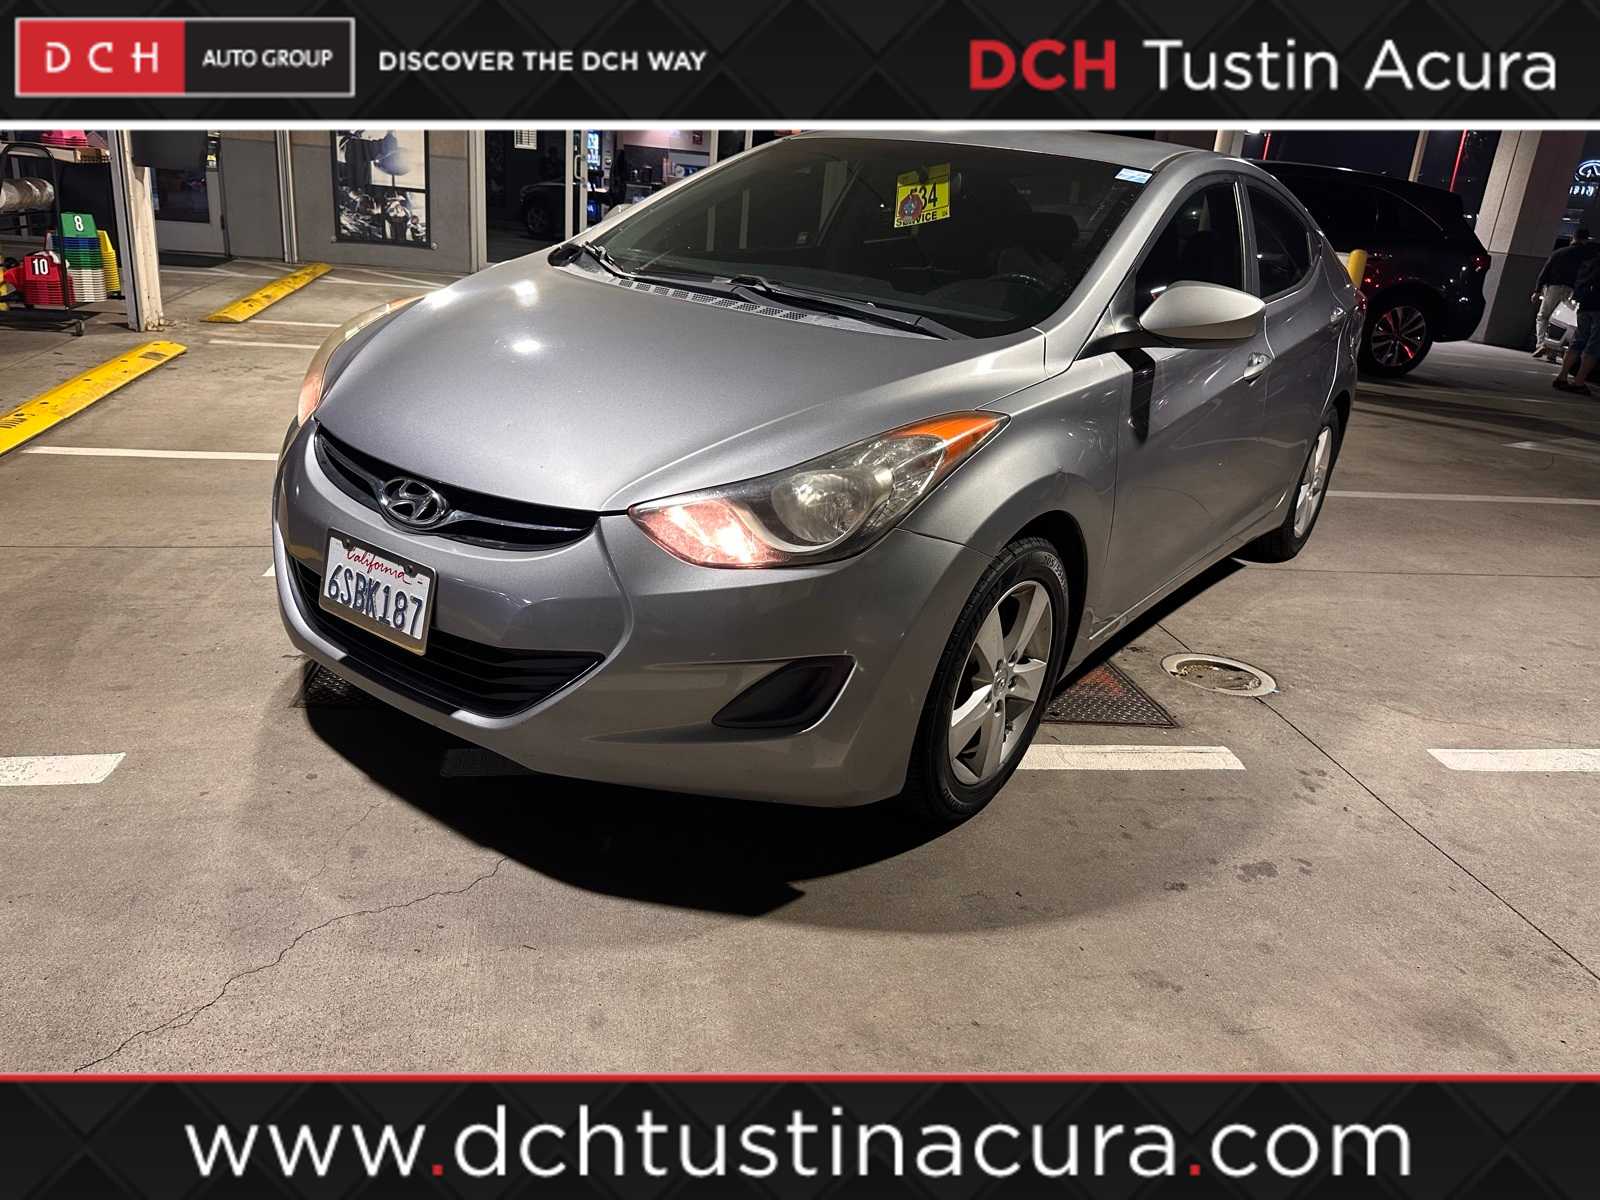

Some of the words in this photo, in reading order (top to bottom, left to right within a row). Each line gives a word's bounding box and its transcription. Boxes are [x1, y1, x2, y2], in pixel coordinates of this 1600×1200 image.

[74, 215, 84, 232] 8
[895, 211, 938, 227] SVICE
[32, 258, 49, 275] 10
[346, 546, 411, 585] California
[328, 564, 423, 636] 6SBK187
